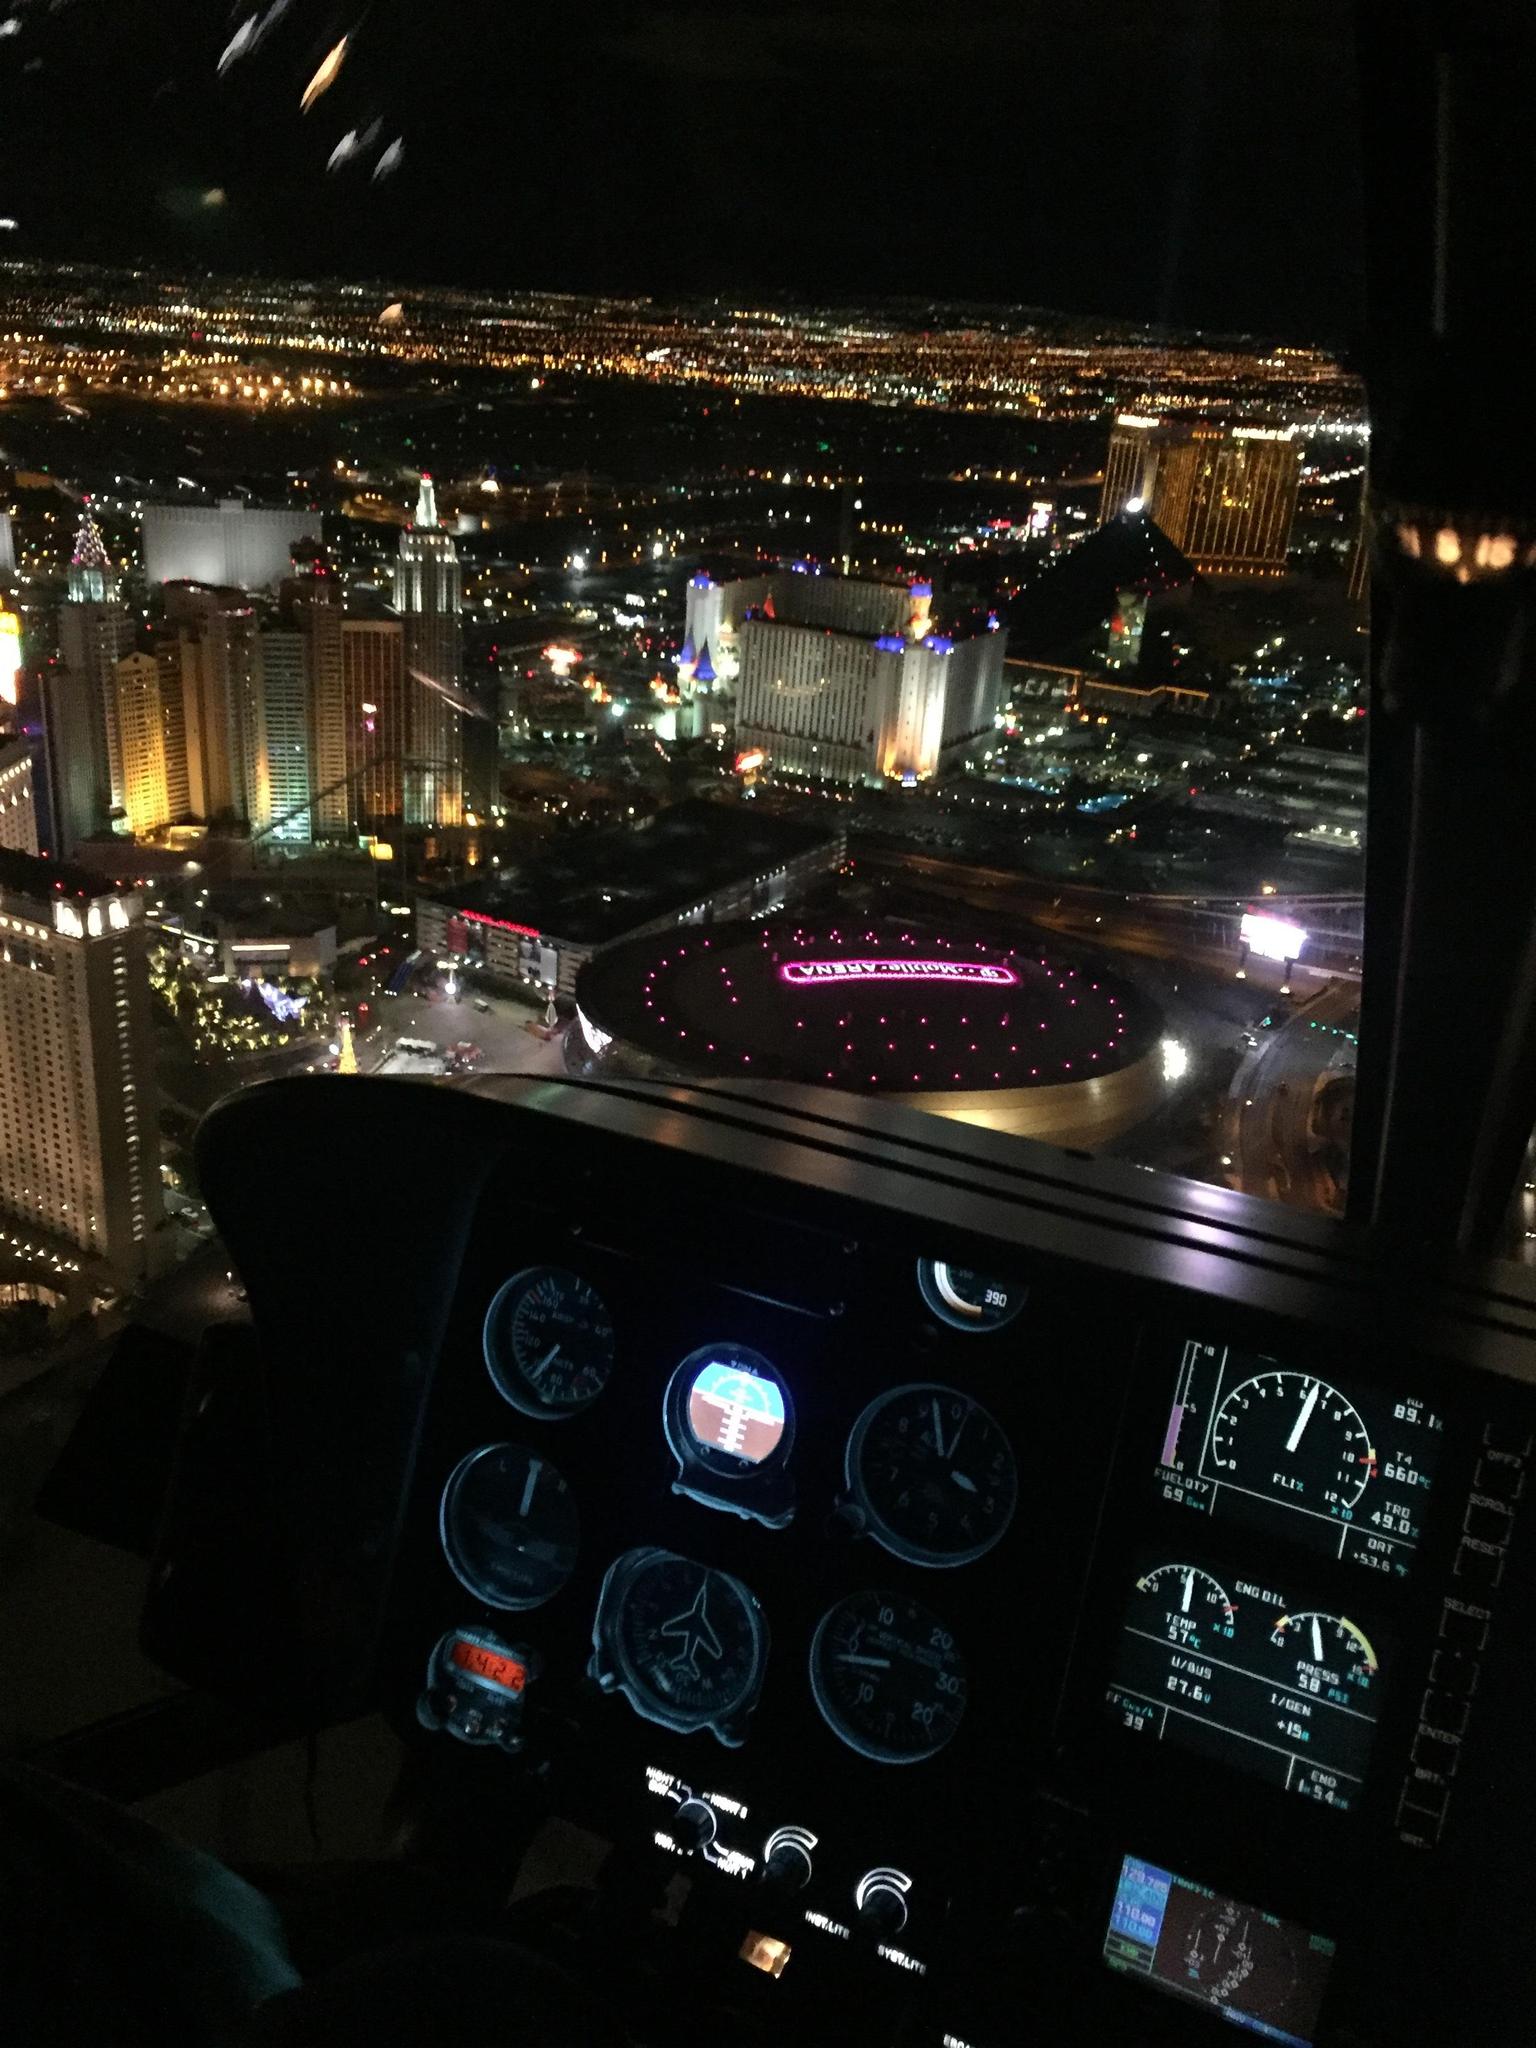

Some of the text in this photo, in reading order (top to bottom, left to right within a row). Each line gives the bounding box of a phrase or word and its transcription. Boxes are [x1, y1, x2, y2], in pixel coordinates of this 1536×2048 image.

[800, 963, 876, 976] ARENA
[985, 1289, 1008, 1307] 390
[1259, 1388, 1266, 1398] 4
[1342, 1452, 1355, 1463] 10
[1397, 1451, 1412, 1465] T4
[1163, 1485, 1183, 1502] 69
[1324, 1491, 1338, 1503] 12
[1235, 1580, 1287, 1608] ENG OIL
[878, 1606, 895, 1626] 10
[1165, 1611, 1197, 1631] TEMP
[930, 1627, 953, 1649] 20
[1297, 1660, 1340, 1686] PRESS
[860, 1681, 875, 1703] 10
[935, 1671, 961, 1695] 30
